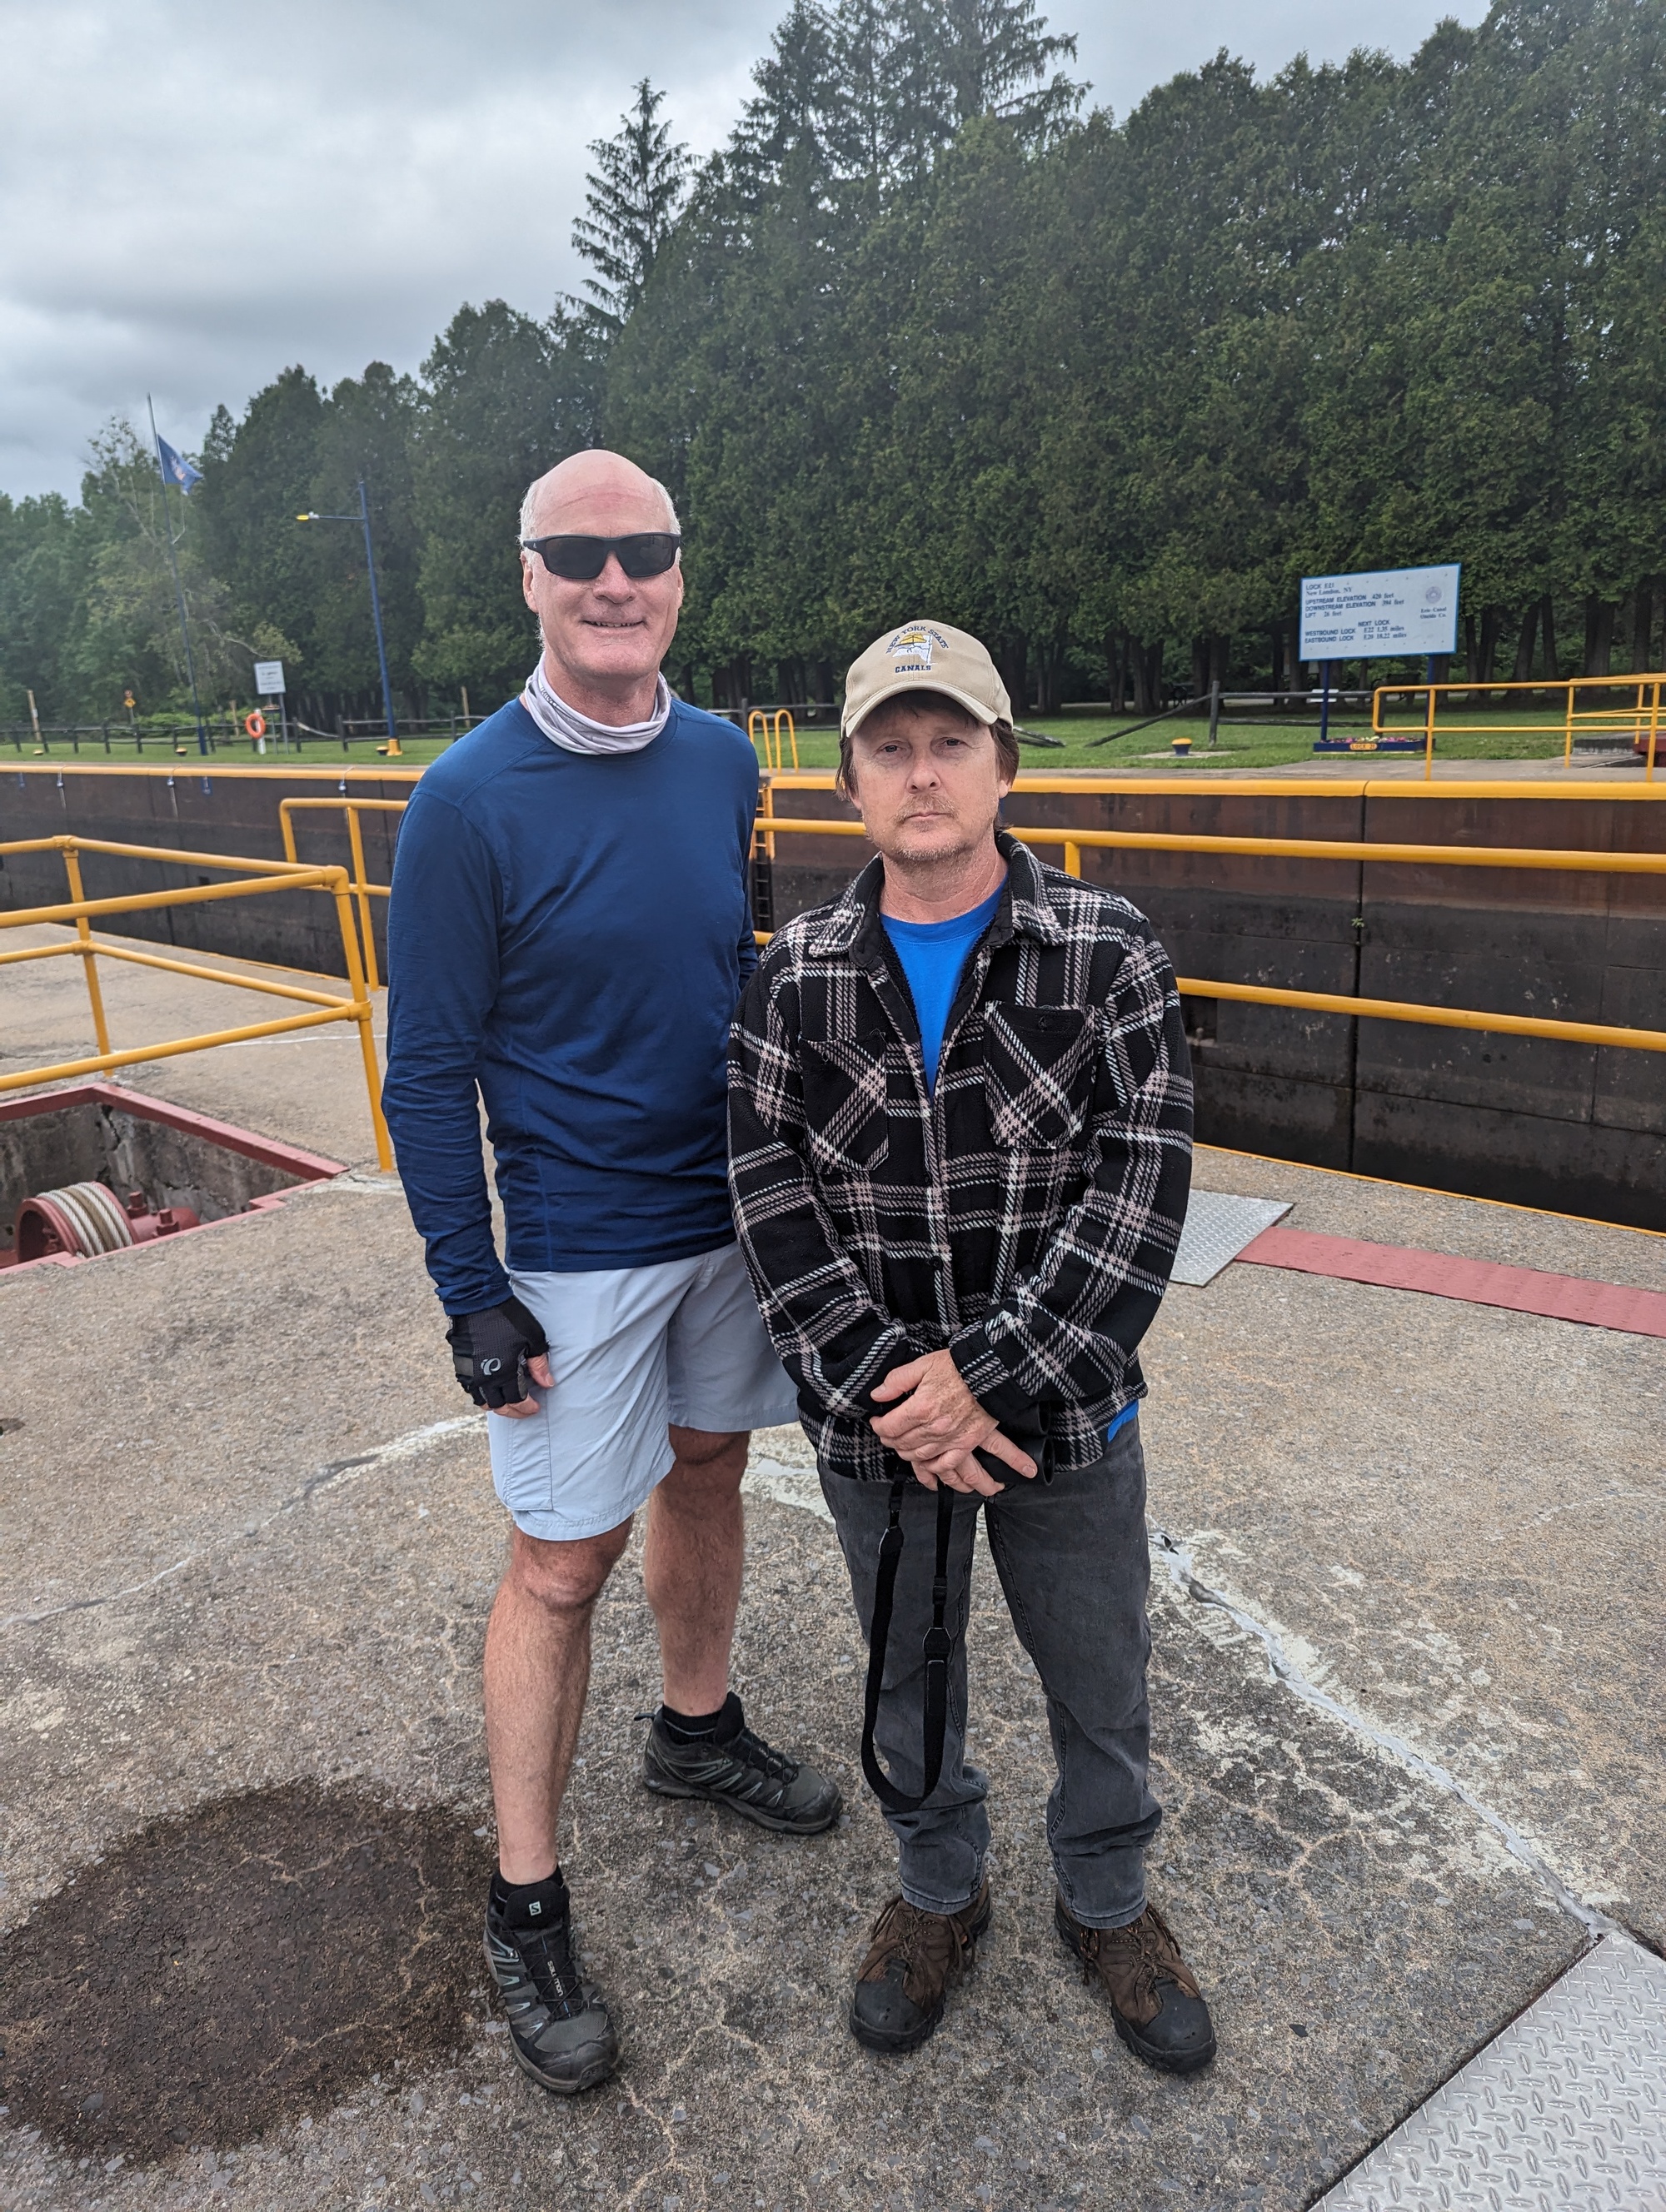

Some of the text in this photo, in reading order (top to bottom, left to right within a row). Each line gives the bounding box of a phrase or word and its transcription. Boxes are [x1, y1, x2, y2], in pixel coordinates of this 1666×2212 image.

[1336, 595, 1367, 603] ELEVATION
[885, 625, 949, 655] NEW YORK STATE
[895, 665, 931, 673] CANALS
